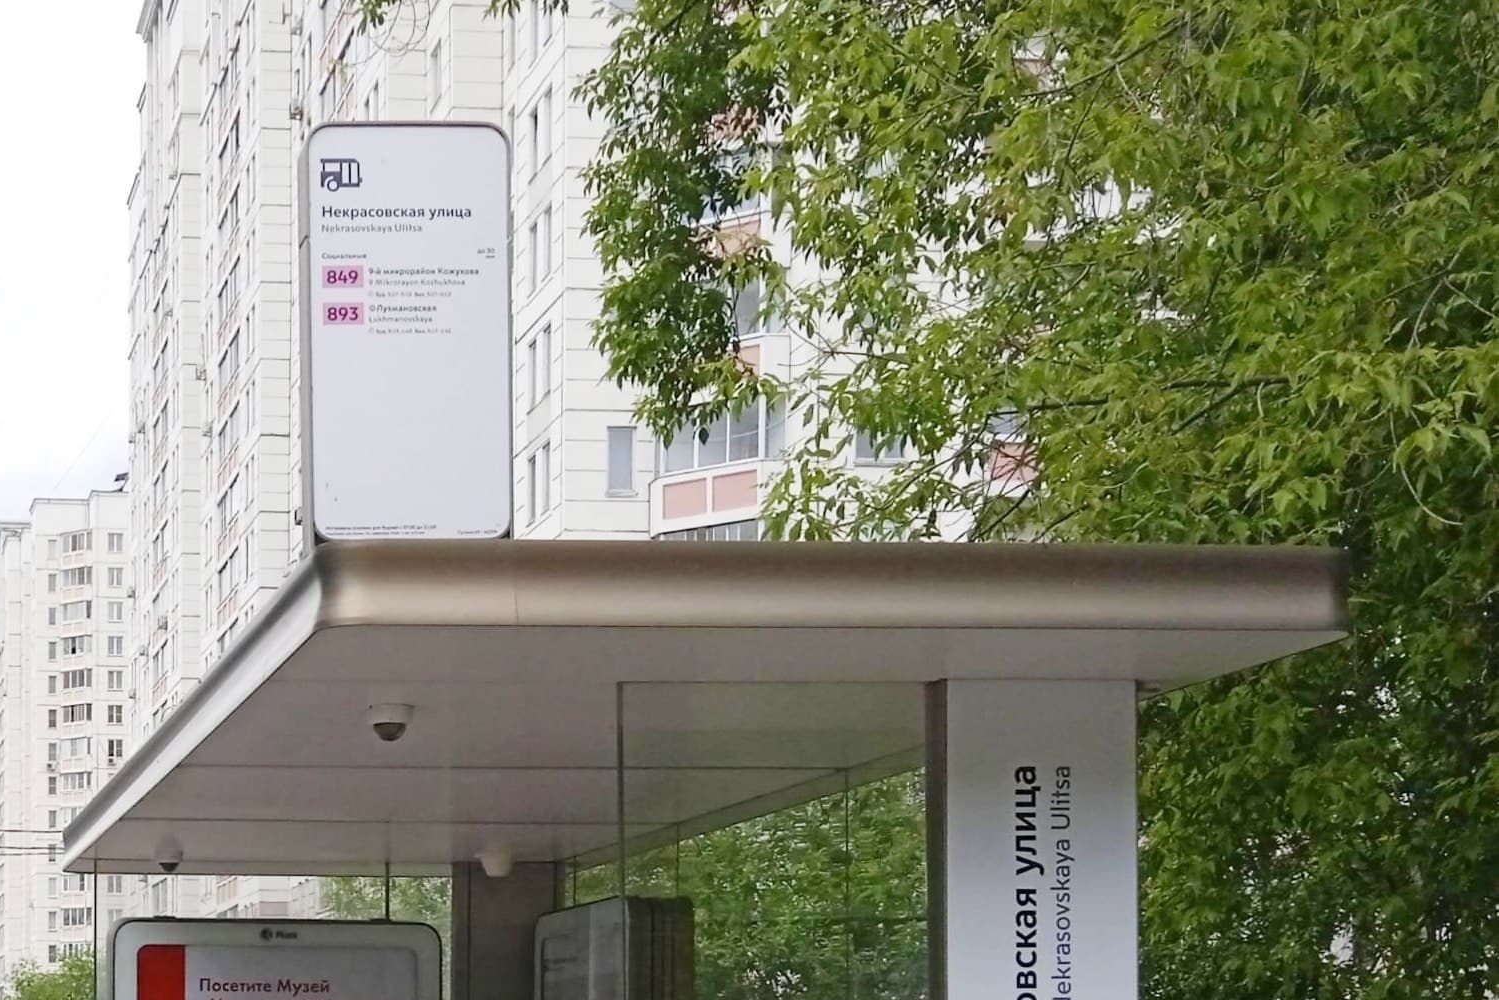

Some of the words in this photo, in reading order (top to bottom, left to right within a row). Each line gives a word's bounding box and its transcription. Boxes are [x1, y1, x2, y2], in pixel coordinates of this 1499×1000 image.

[321, 205, 425, 221] Некрасовская
[428, 208, 472, 221] улица
[321, 224, 393, 234] Nekrasovskaya
[394, 224, 423, 233] Ulitsa
[326, 269, 359, 285] 849
[383, 267, 436, 277] микрорайон
[437, 267, 480, 277] Кожухова
[327, 306, 359, 322] 893
[1049, 764, 1072, 830] Ulitsa
[1013, 764, 1045, 876] улица
[199, 978, 272, 993] Посетите
[277, 979, 330, 996] Музей
